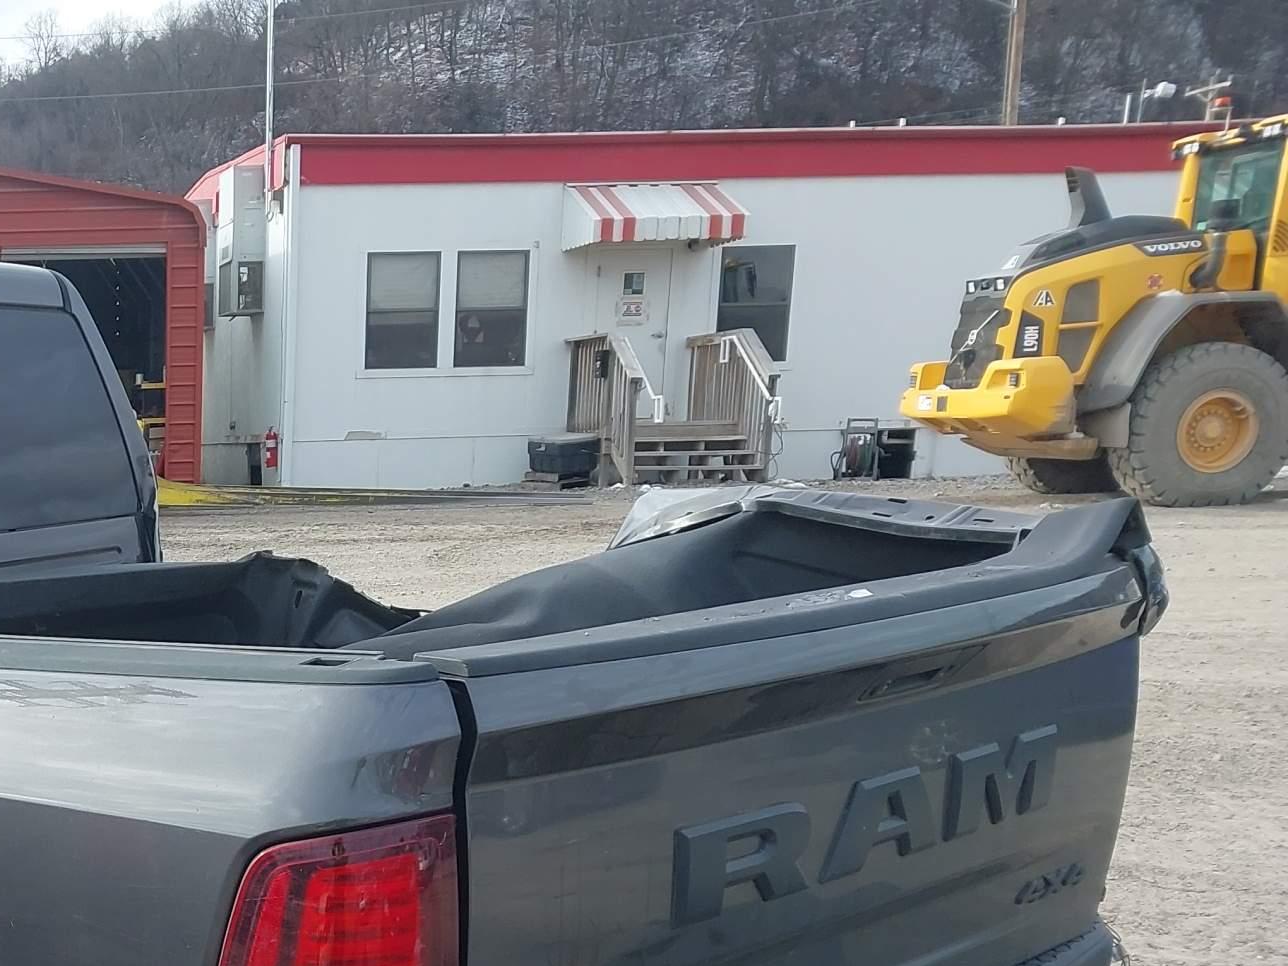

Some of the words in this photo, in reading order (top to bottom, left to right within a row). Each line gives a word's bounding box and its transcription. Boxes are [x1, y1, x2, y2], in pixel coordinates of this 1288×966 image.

[1143, 238, 1202, 253] VOLVO
[1023, 325, 1040, 352] L90H
[671, 724, 1058, 930] RAM
